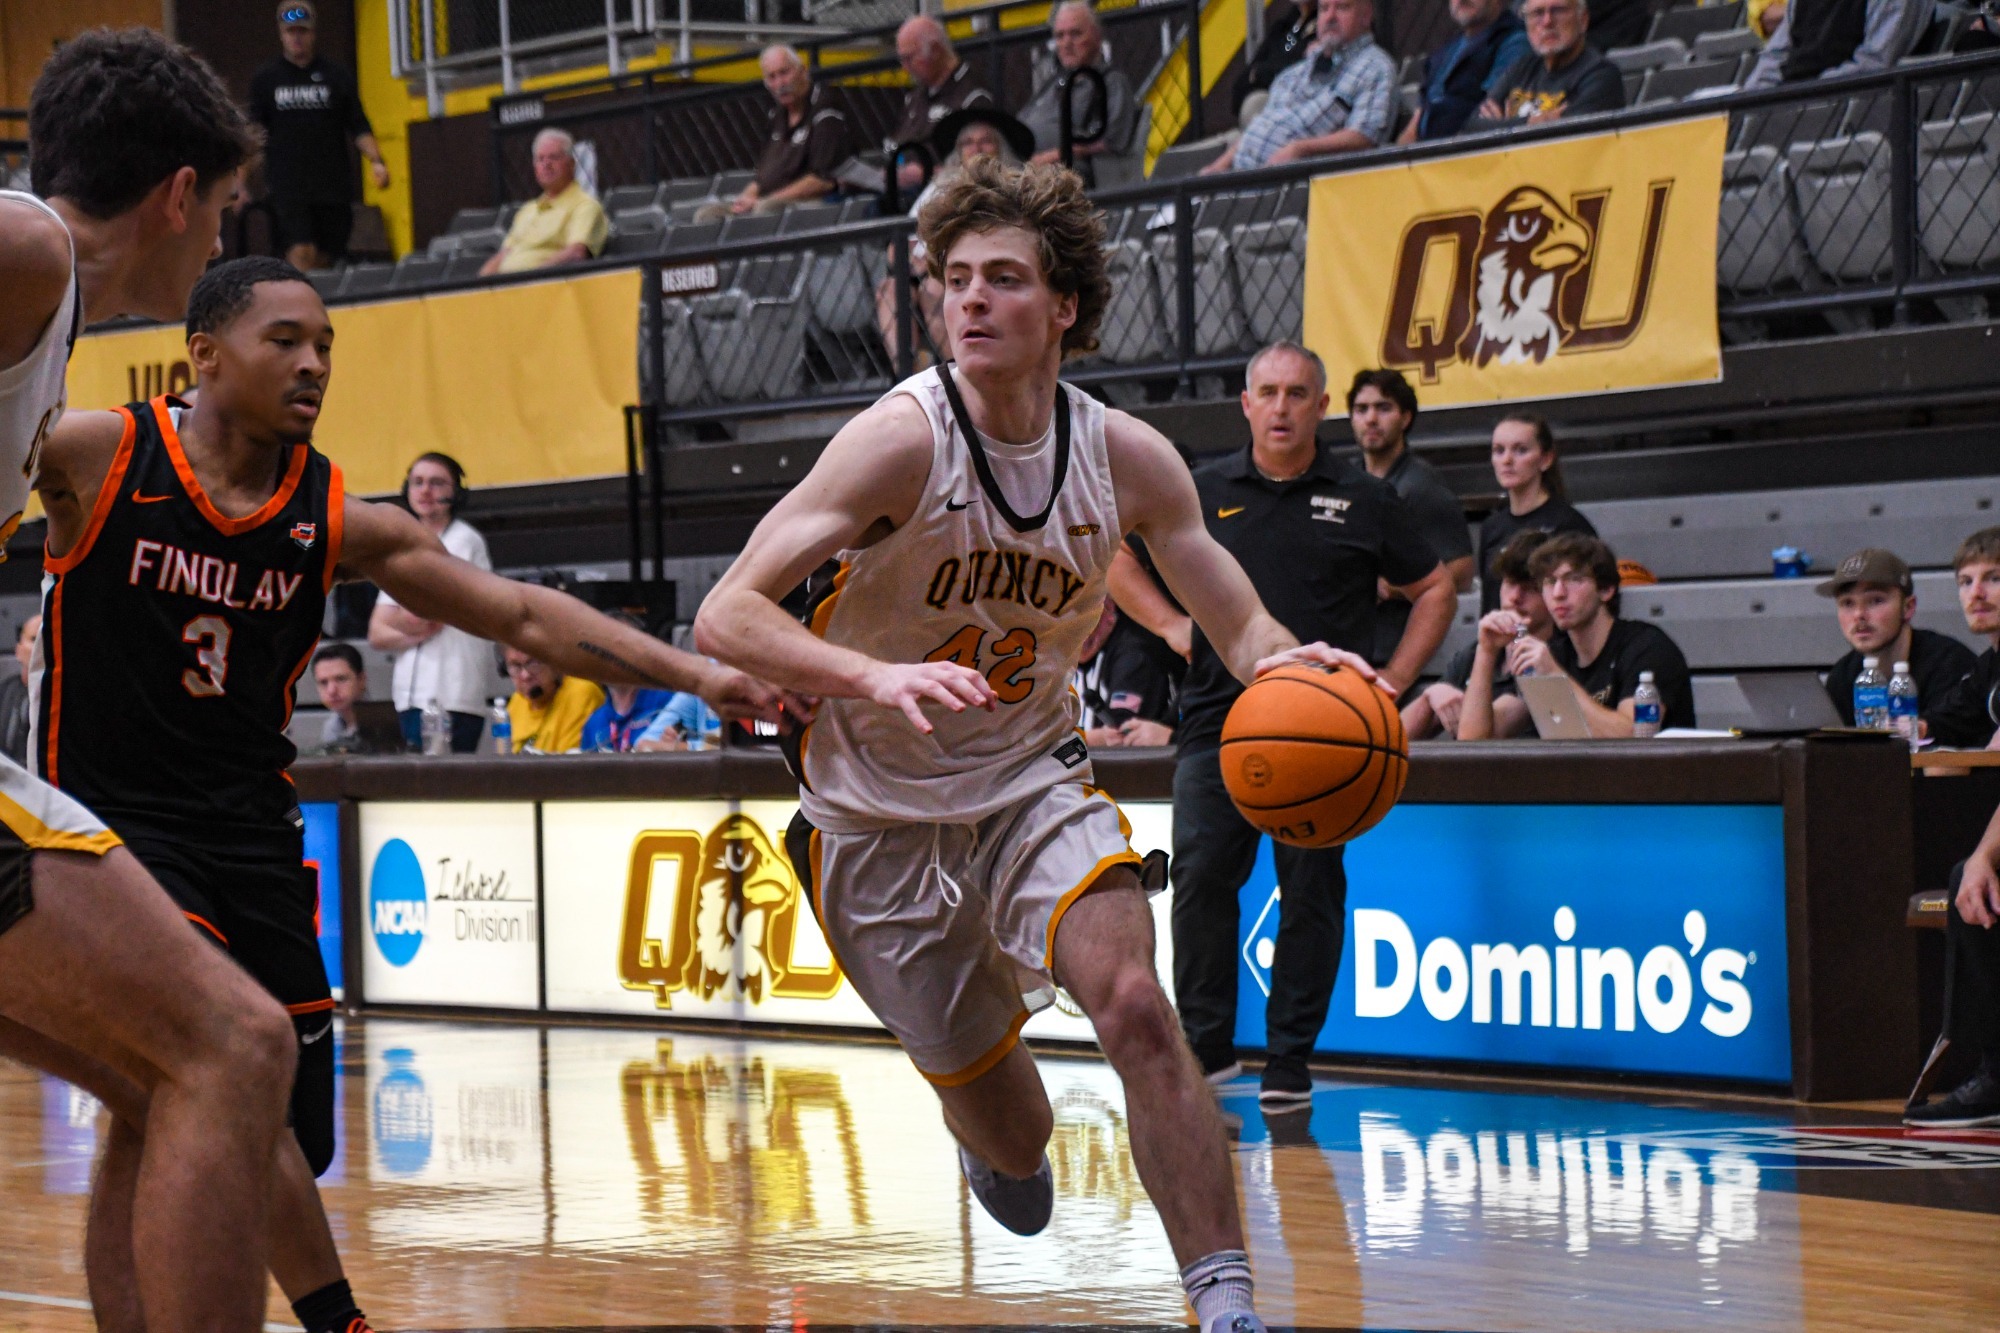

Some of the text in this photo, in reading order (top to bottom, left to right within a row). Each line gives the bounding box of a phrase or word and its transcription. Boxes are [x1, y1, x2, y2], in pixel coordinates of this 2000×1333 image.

[661, 264, 718, 293] RESERVED
[128, 537, 304, 611] FINDLAY
[924, 550, 1085, 617] QUINCY
[181, 613, 233, 698] 3
[922, 623, 1037, 704] 42
[374, 900, 428, 936] NCAA
[454, 907, 521, 942] Division
[1353, 905, 1753, 1038] Domino's
